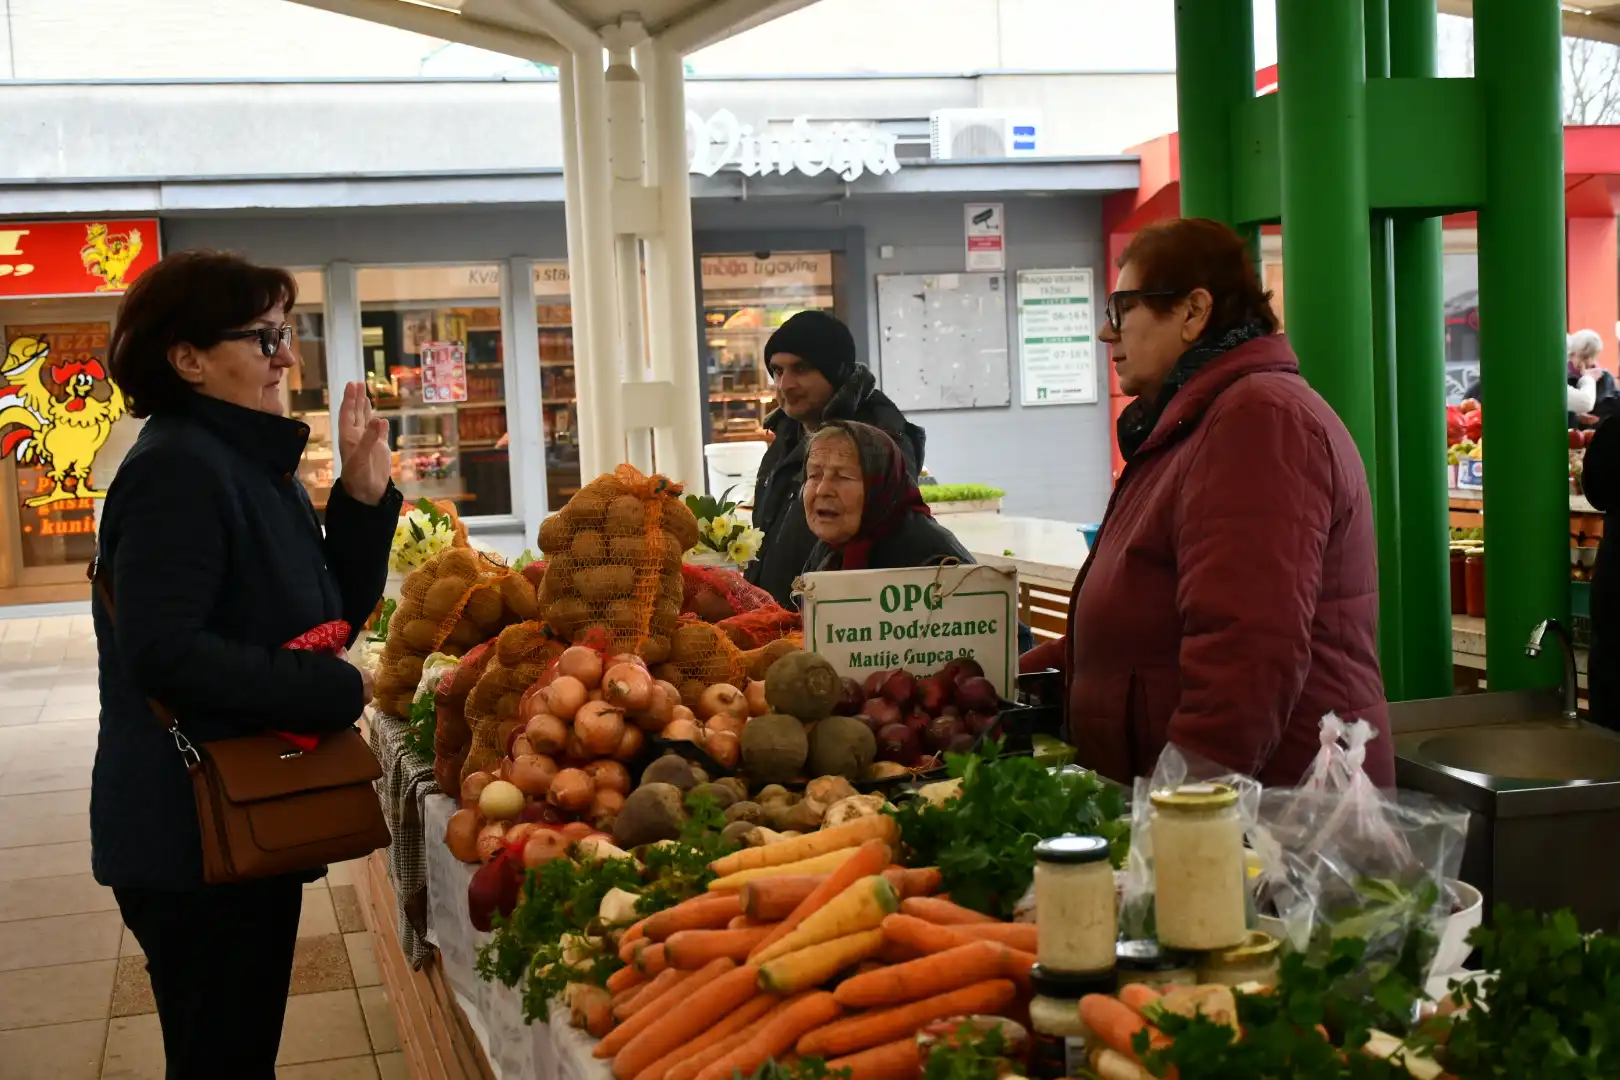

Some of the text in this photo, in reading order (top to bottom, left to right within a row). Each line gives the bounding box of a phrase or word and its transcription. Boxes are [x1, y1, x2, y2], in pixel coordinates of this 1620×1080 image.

[880, 582, 943, 613] OPG
[826, 618, 998, 644] Ivan Podvezanec
[849, 651, 899, 669] Matije
[904, 648, 953, 667] Gupca
